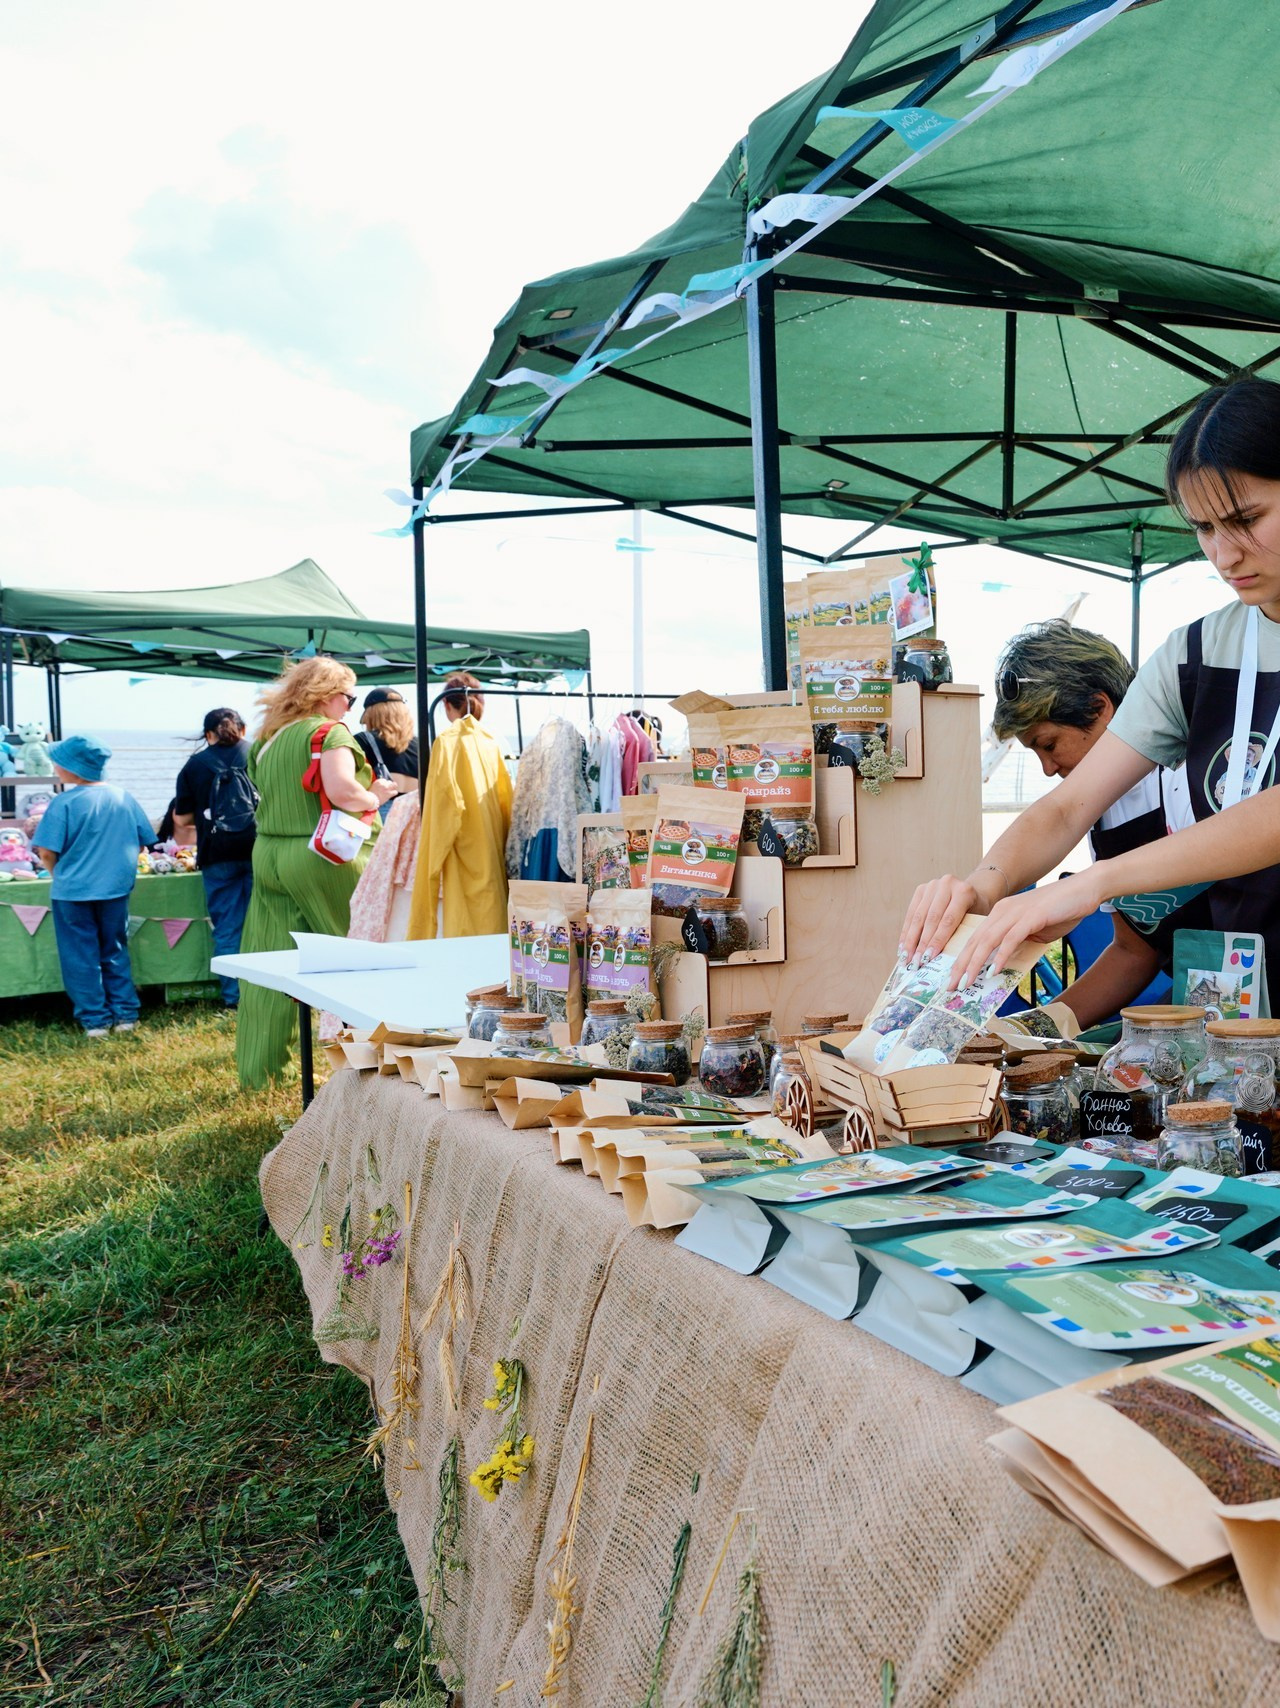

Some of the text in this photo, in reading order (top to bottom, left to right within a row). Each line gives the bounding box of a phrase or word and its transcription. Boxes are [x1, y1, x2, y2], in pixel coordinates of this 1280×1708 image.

[821, 704, 843, 713] тебя
[846, 703, 884, 714] люблю
[742, 786, 791, 797] Санрайз
[660, 864, 717, 880] Витаминка
[1244, 1350, 1273, 1368] чай
